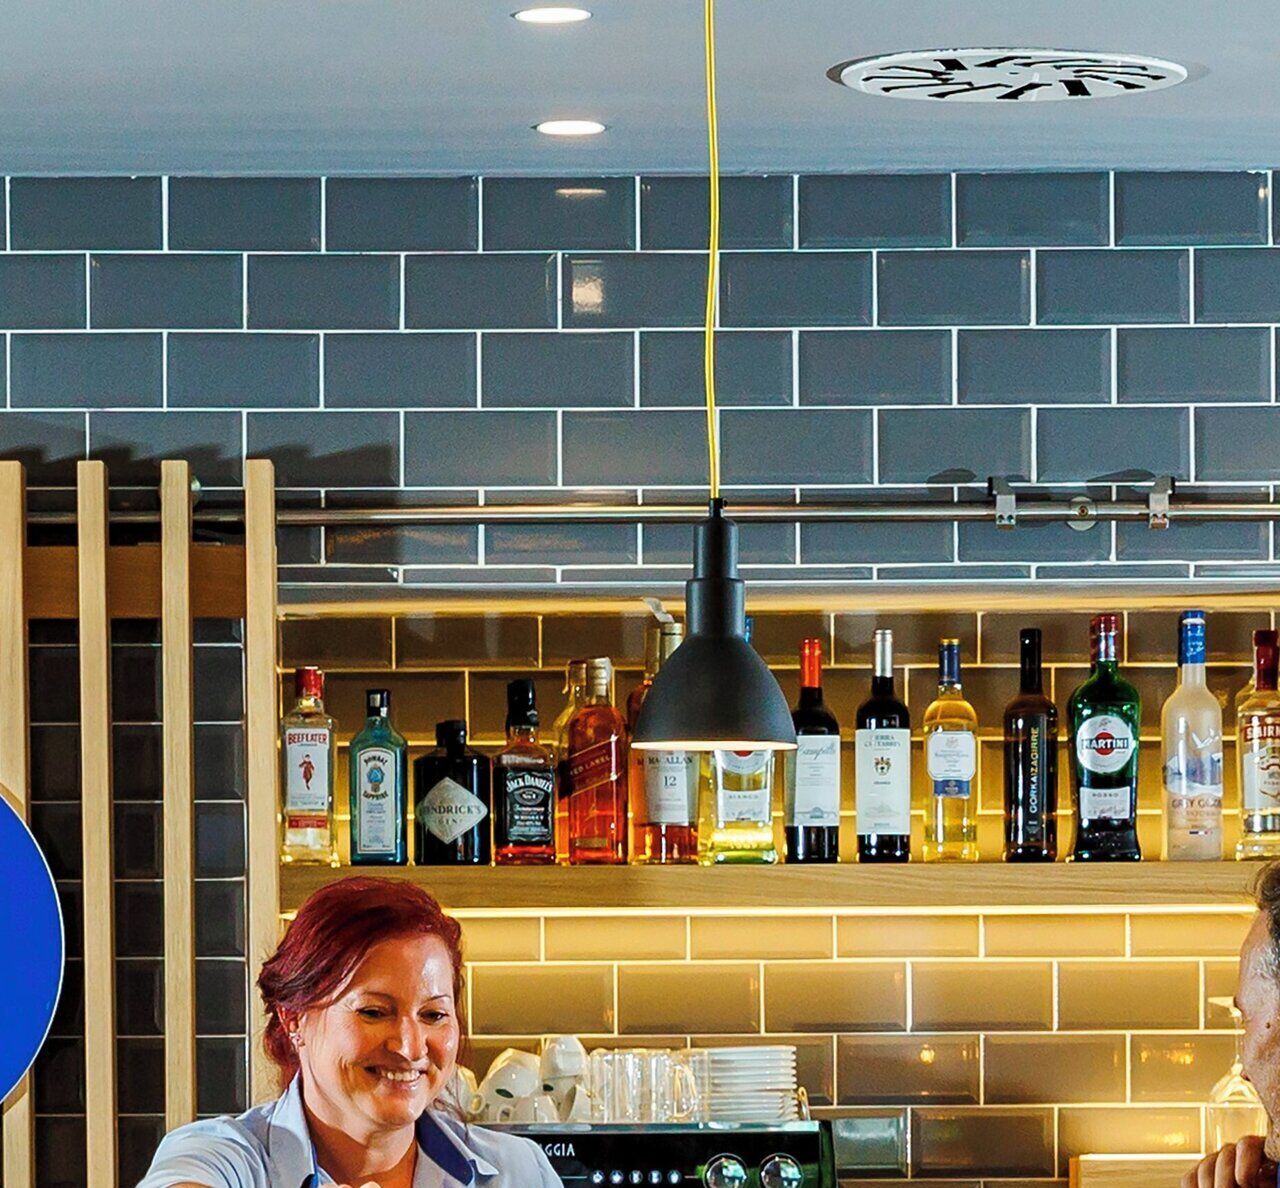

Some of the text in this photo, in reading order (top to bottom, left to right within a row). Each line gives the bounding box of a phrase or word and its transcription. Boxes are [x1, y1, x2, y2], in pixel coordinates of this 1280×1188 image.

[288, 732, 327, 744] BEEFEATER
[1082, 738, 1128, 749] MARTINI
[648, 756, 693, 765] MAALLAN
[664, 775, 677, 786] 12
[420, 804, 482, 816] ENDRICK'S
